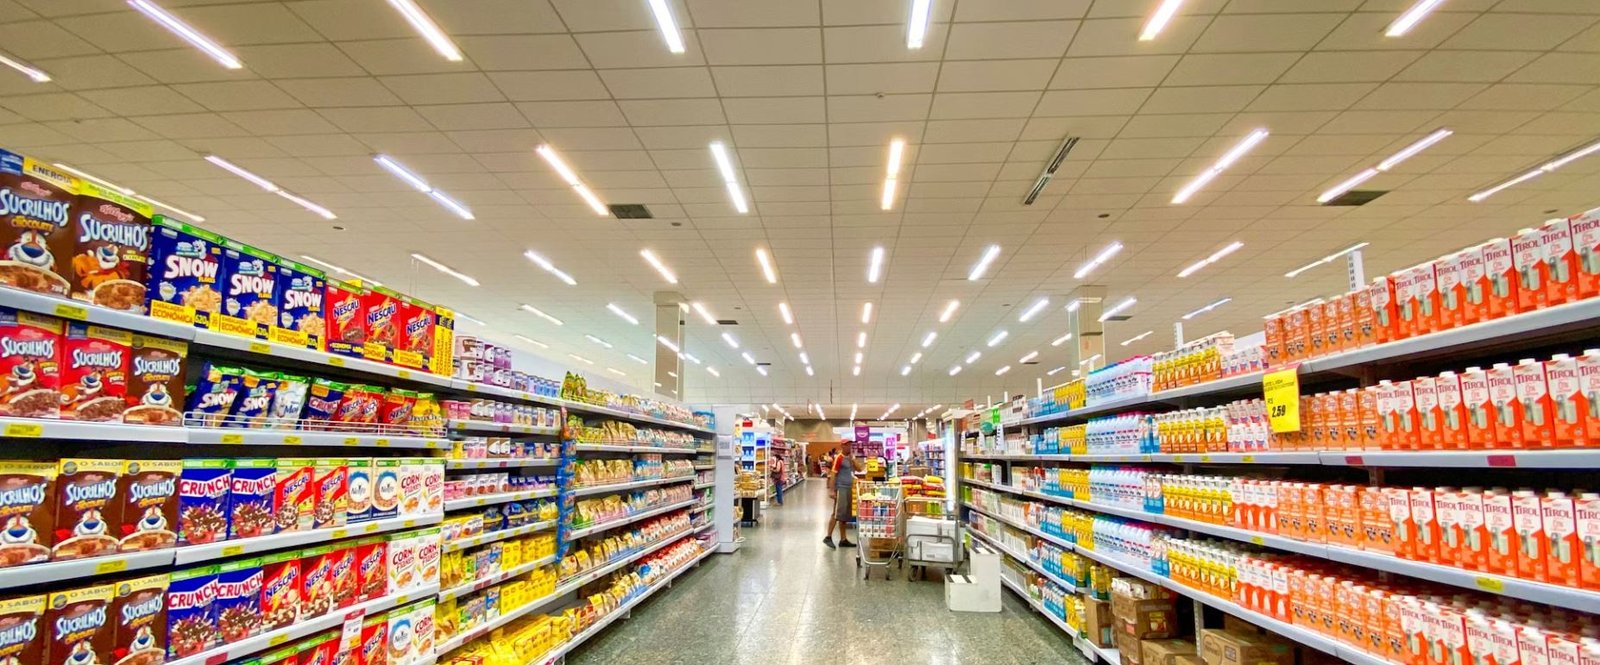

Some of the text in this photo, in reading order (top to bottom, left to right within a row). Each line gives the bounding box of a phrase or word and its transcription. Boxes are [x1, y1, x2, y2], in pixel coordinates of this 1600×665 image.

[0, 189, 70, 227] SUCRILHOS
[80, 213, 149, 252] SUCRILHOS
[1541, 230, 1569, 245] TIROL
[1485, 249, 1510, 262] TIROL
[1514, 240, 1541, 254] TIROL
[164, 254, 219, 279] SNOW
[1437, 265, 1459, 276] TIROL
[1460, 258, 1483, 270] TIROL
[230, 273, 274, 296] SNOW
[284, 289, 322, 310] SNOW
[152, 308, 193, 324] ECONÔMICA
[333, 299, 360, 319] NESCAU
[367, 303, 397, 325] NESCAU
[406, 314, 432, 335] NESCAU
[1, 336, 55, 359] SUCRILHOS
[72, 349, 122, 369] SUCRILHOS
[134, 357, 181, 376] SUCRILHOS
[1489, 377, 1513, 387] TIROL
[1515, 373, 1544, 384] TIROL
[1549, 369, 1577, 380] TIROL
[1416, 386, 1436, 395] TIROL
[1437, 383, 1459, 393] TIROL
[1463, 380, 1486, 391] TIROL
[198, 391, 237, 409] SNOW
[179, 473, 230, 496] CRUNCH
[233, 474, 276, 494] CRUNCH
[283, 475, 310, 496] NESCAU
[320, 474, 344, 494] NESCAU
[401, 474, 421, 488] CORN
[425, 473, 441, 487] CORN
[65, 479, 117, 506] SUCRILHOS
[130, 478, 176, 503] SUCRILHOS
[1390, 497, 1407, 507] TIROL
[1411, 498, 1430, 508] TIROL
[1436, 499, 1457, 510] TIROL
[1457, 501, 1481, 512] TIROL
[1484, 503, 1510, 514] TIROL
[1514, 505, 1540, 517] TIROL
[1543, 506, 1572, 518] TIROL
[393, 547, 413, 565] CORN
[418, 542, 438, 560] CORN
[361, 547, 384, 575] NESCAU
[265, 567, 298, 600] NESCAU
[305, 560, 331, 589] NESCAU
[82, 586, 114, 597] SABOR
[169, 579, 219, 608] CRUNCH
[218, 572, 264, 599] CRUNCH
[122, 593, 164, 626] SUCRILHOS
[56, 605, 107, 641] SUCRILHOS
[415, 615, 432, 634] CORN
[1441, 620, 1461, 633] TIROL
[363, 627, 386, 656] NESCAU
[1467, 627, 1490, 641] TIROL
[1491, 633, 1515, 648] TIROL
[1519, 640, 1545, 656] TIROL
[1549, 648, 1575, 664] TIROL
